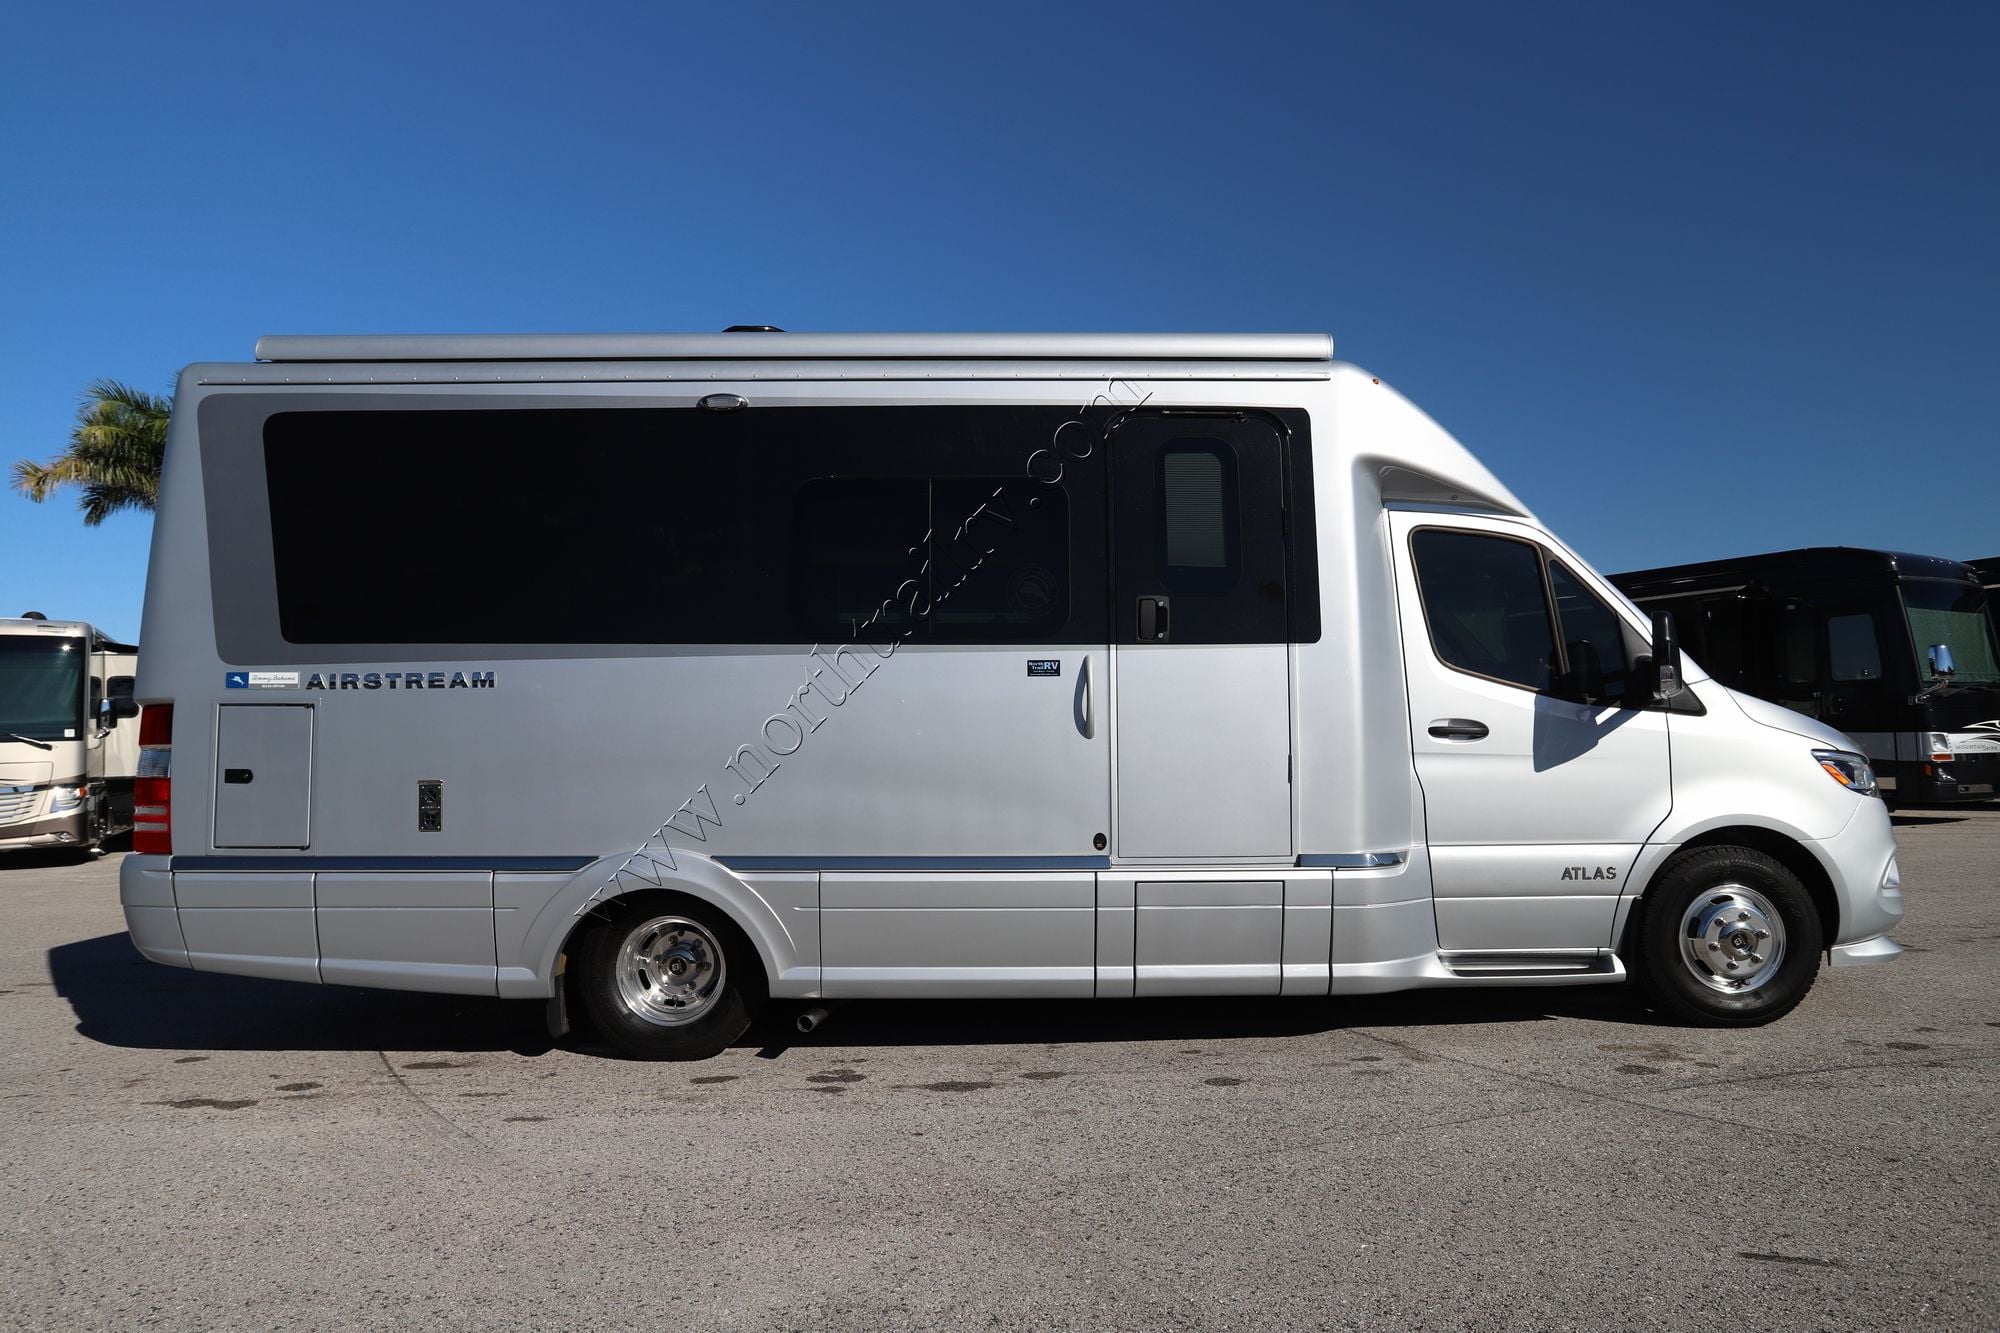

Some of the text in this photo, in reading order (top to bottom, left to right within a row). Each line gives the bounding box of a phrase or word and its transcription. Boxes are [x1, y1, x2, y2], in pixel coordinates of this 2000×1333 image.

[1043, 661, 1059, 670] RV
[306, 671, 497, 690] AIRSTREAM
[1560, 866, 1617, 880] ATLAS
